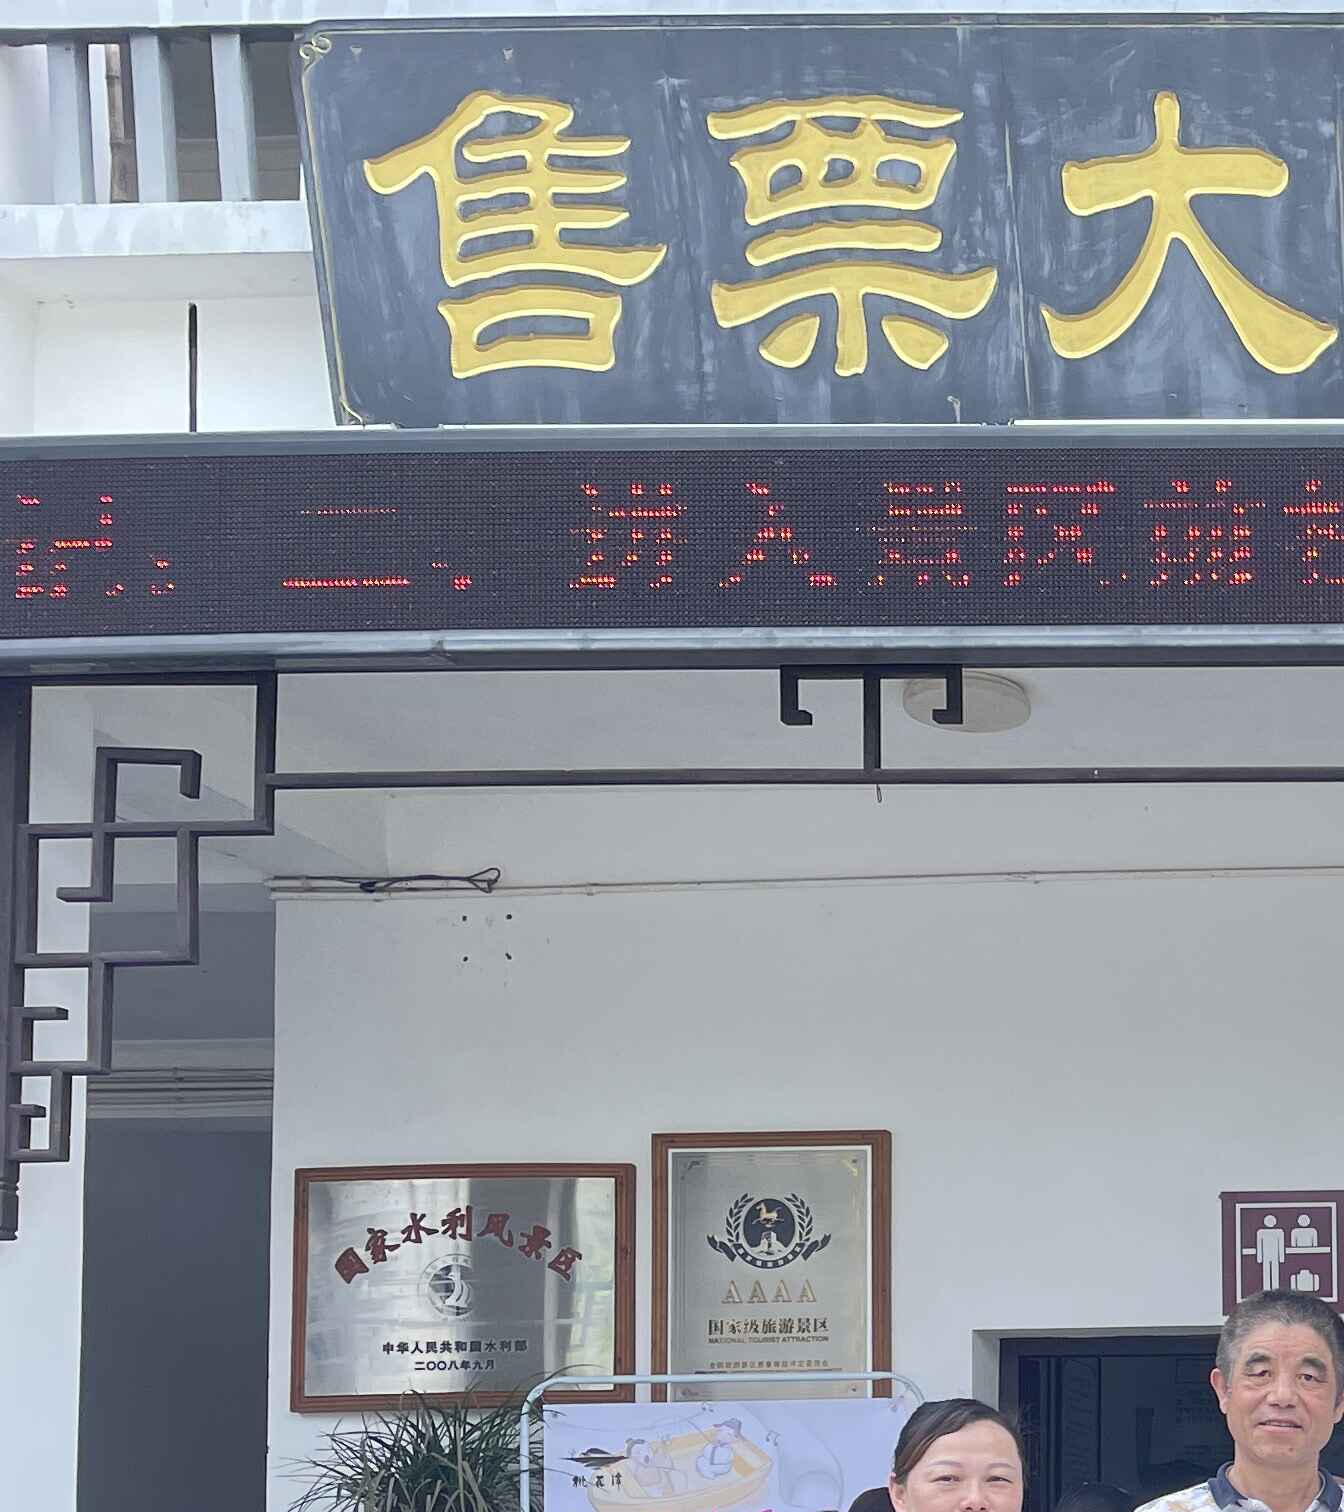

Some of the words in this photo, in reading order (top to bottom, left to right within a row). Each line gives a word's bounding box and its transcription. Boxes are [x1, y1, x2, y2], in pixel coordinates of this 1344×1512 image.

[334, 1204, 583, 1284] 国家水利风景区
[708, 1316, 829, 1336] 国家级旅游景区
[382, 1338, 528, 1356] 中华人民共和国水利部
[708, 1337, 747, 1345] NATIONAL
[782, 1335, 829, 1344] ATTRACTION
